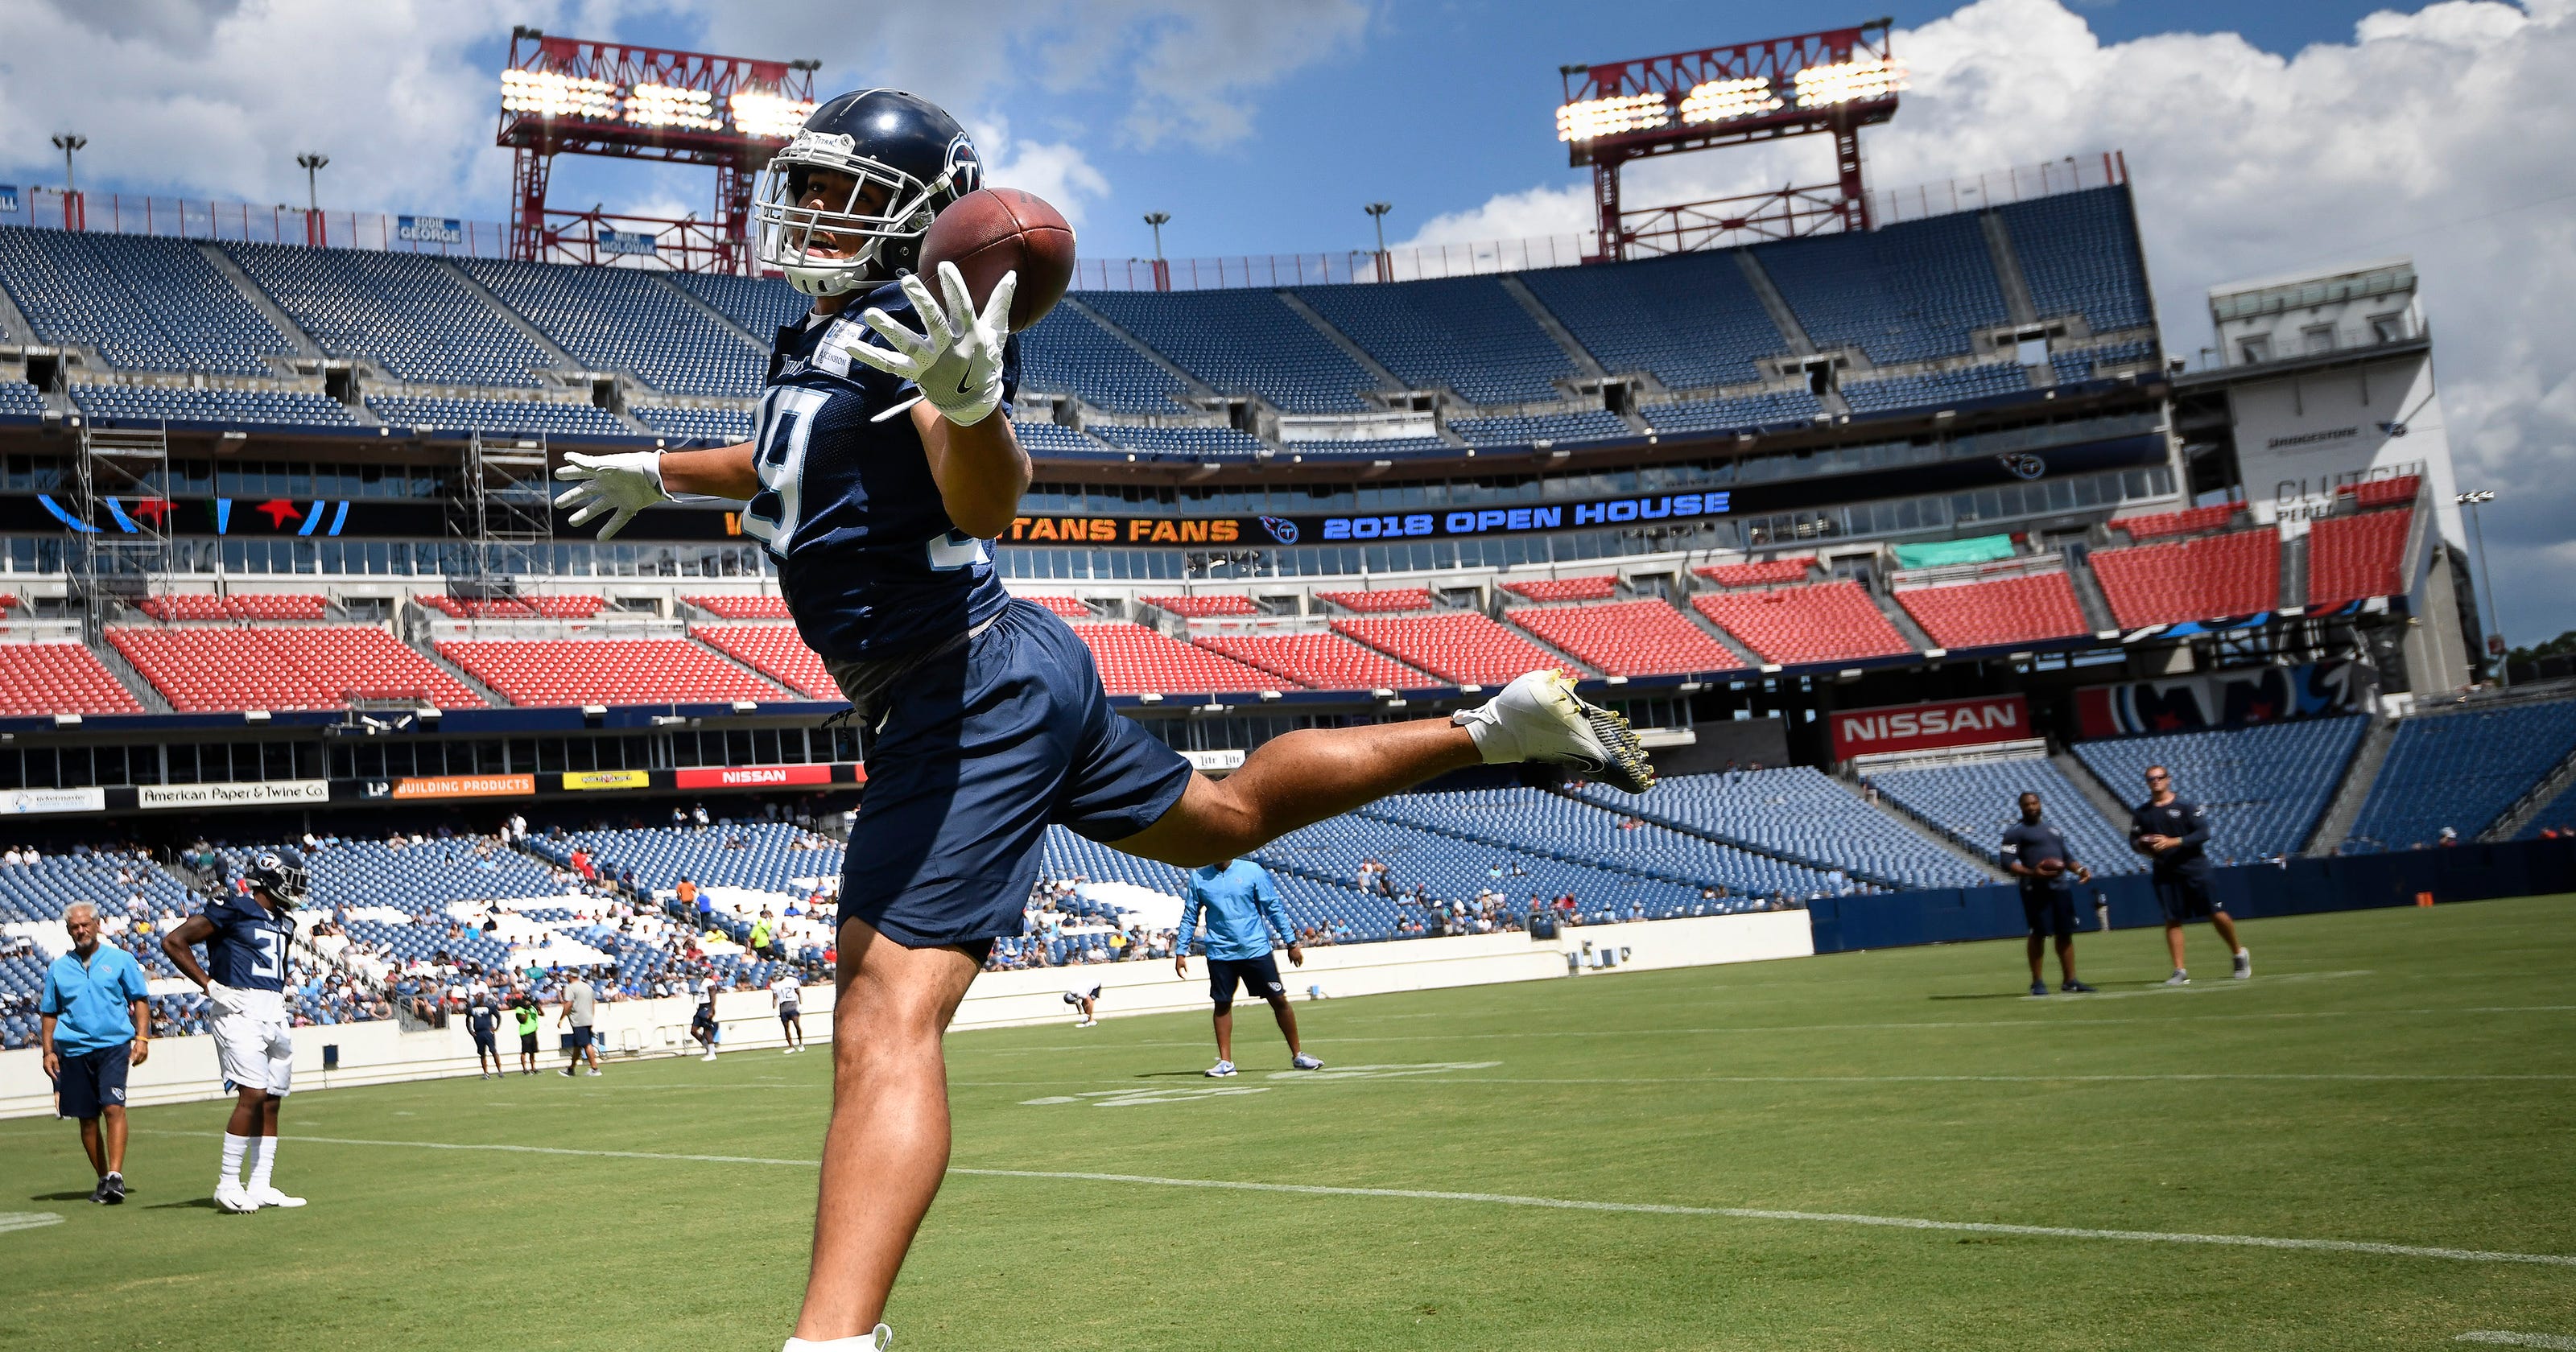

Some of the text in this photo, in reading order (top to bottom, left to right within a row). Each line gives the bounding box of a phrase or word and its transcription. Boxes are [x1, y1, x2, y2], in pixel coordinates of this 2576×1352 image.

[415, 216, 444, 228] EDDIE
[401, 226, 460, 242] GEORGE
[615, 230, 640, 242] MIKE
[601, 241, 656, 254] HOLOVAK
[1323, 491, 1730, 540] 2018 OPEN HOUSE
[1009, 517, 1240, 542] TANS FANS
[1843, 703, 2016, 742] NISSAN
[723, 770, 786, 783] NISSAN
[145, 784, 325, 802] American Paper & Twine Co.
[367, 779, 529, 797] LP BUILDING PRODUCTS
